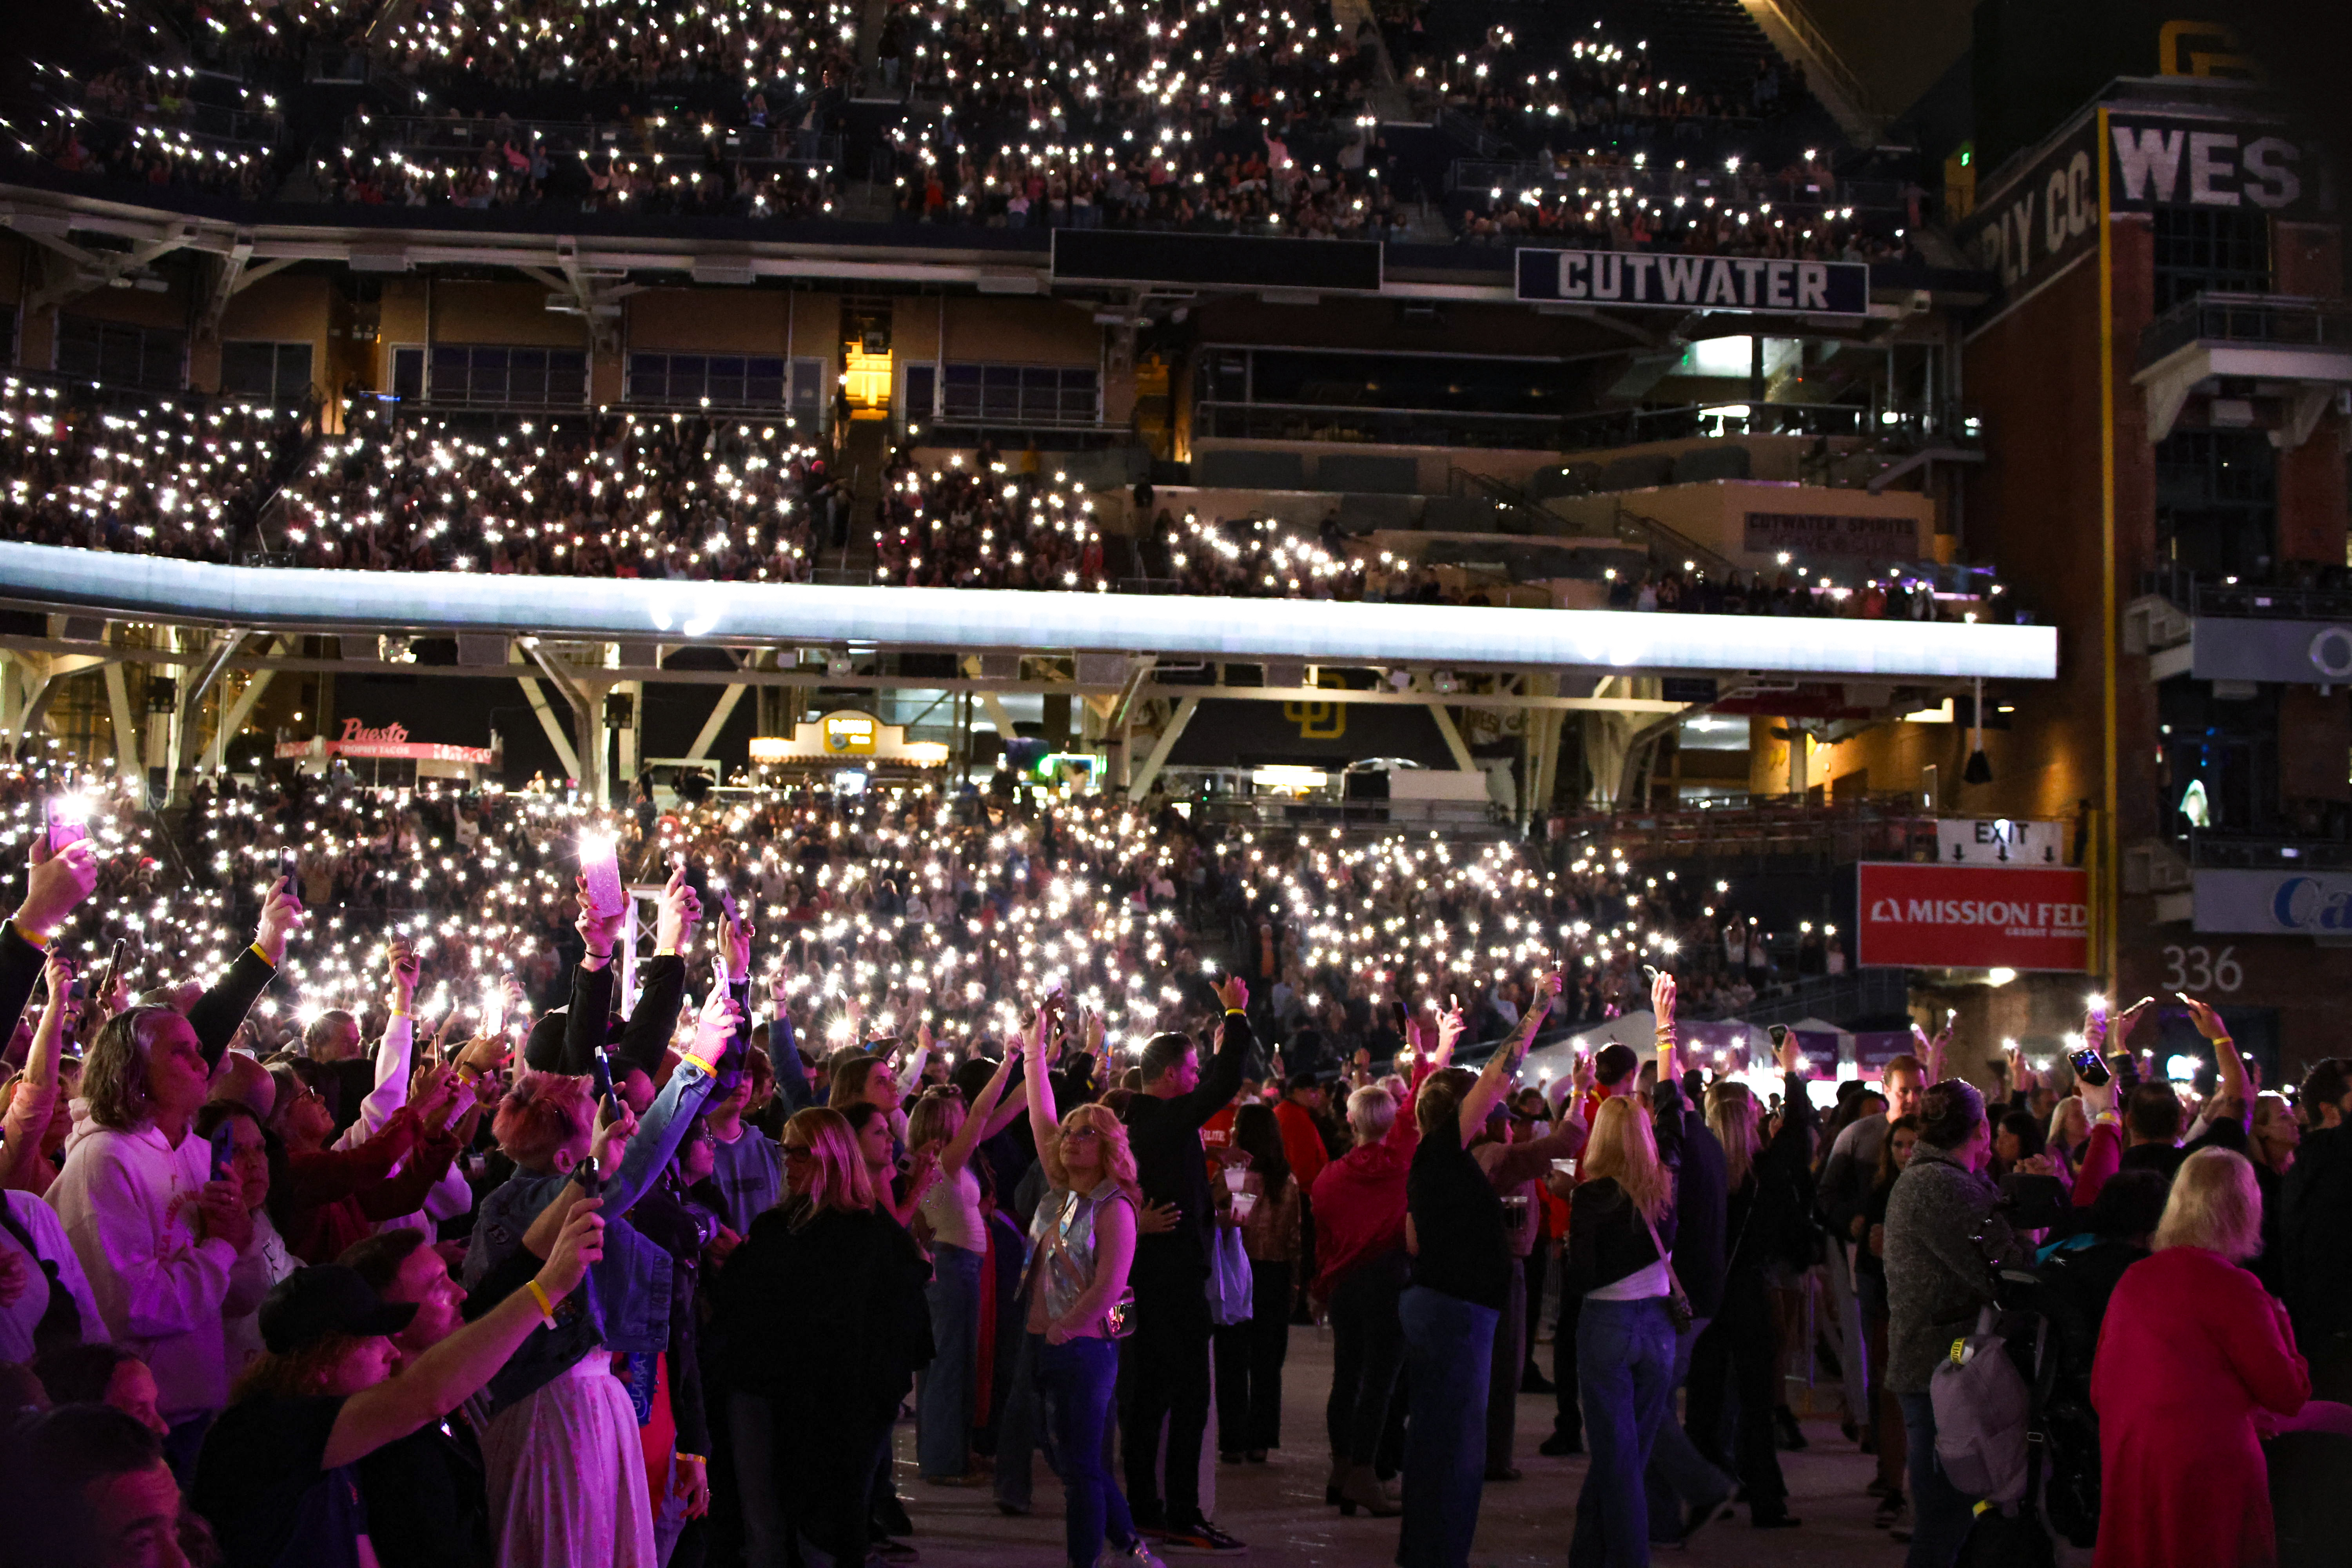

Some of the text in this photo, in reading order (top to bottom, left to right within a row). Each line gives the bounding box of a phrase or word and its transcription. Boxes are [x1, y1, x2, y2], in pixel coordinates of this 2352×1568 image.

[1558, 252, 1828, 309] CUTWATER
[339, 717, 409, 743] Puesto
[379, 746, 409, 755] TACOS
[1975, 822, 2028, 844] EXIT
[1907, 899, 2088, 927] MISSION FED
[2161, 945, 2243, 992] 336
